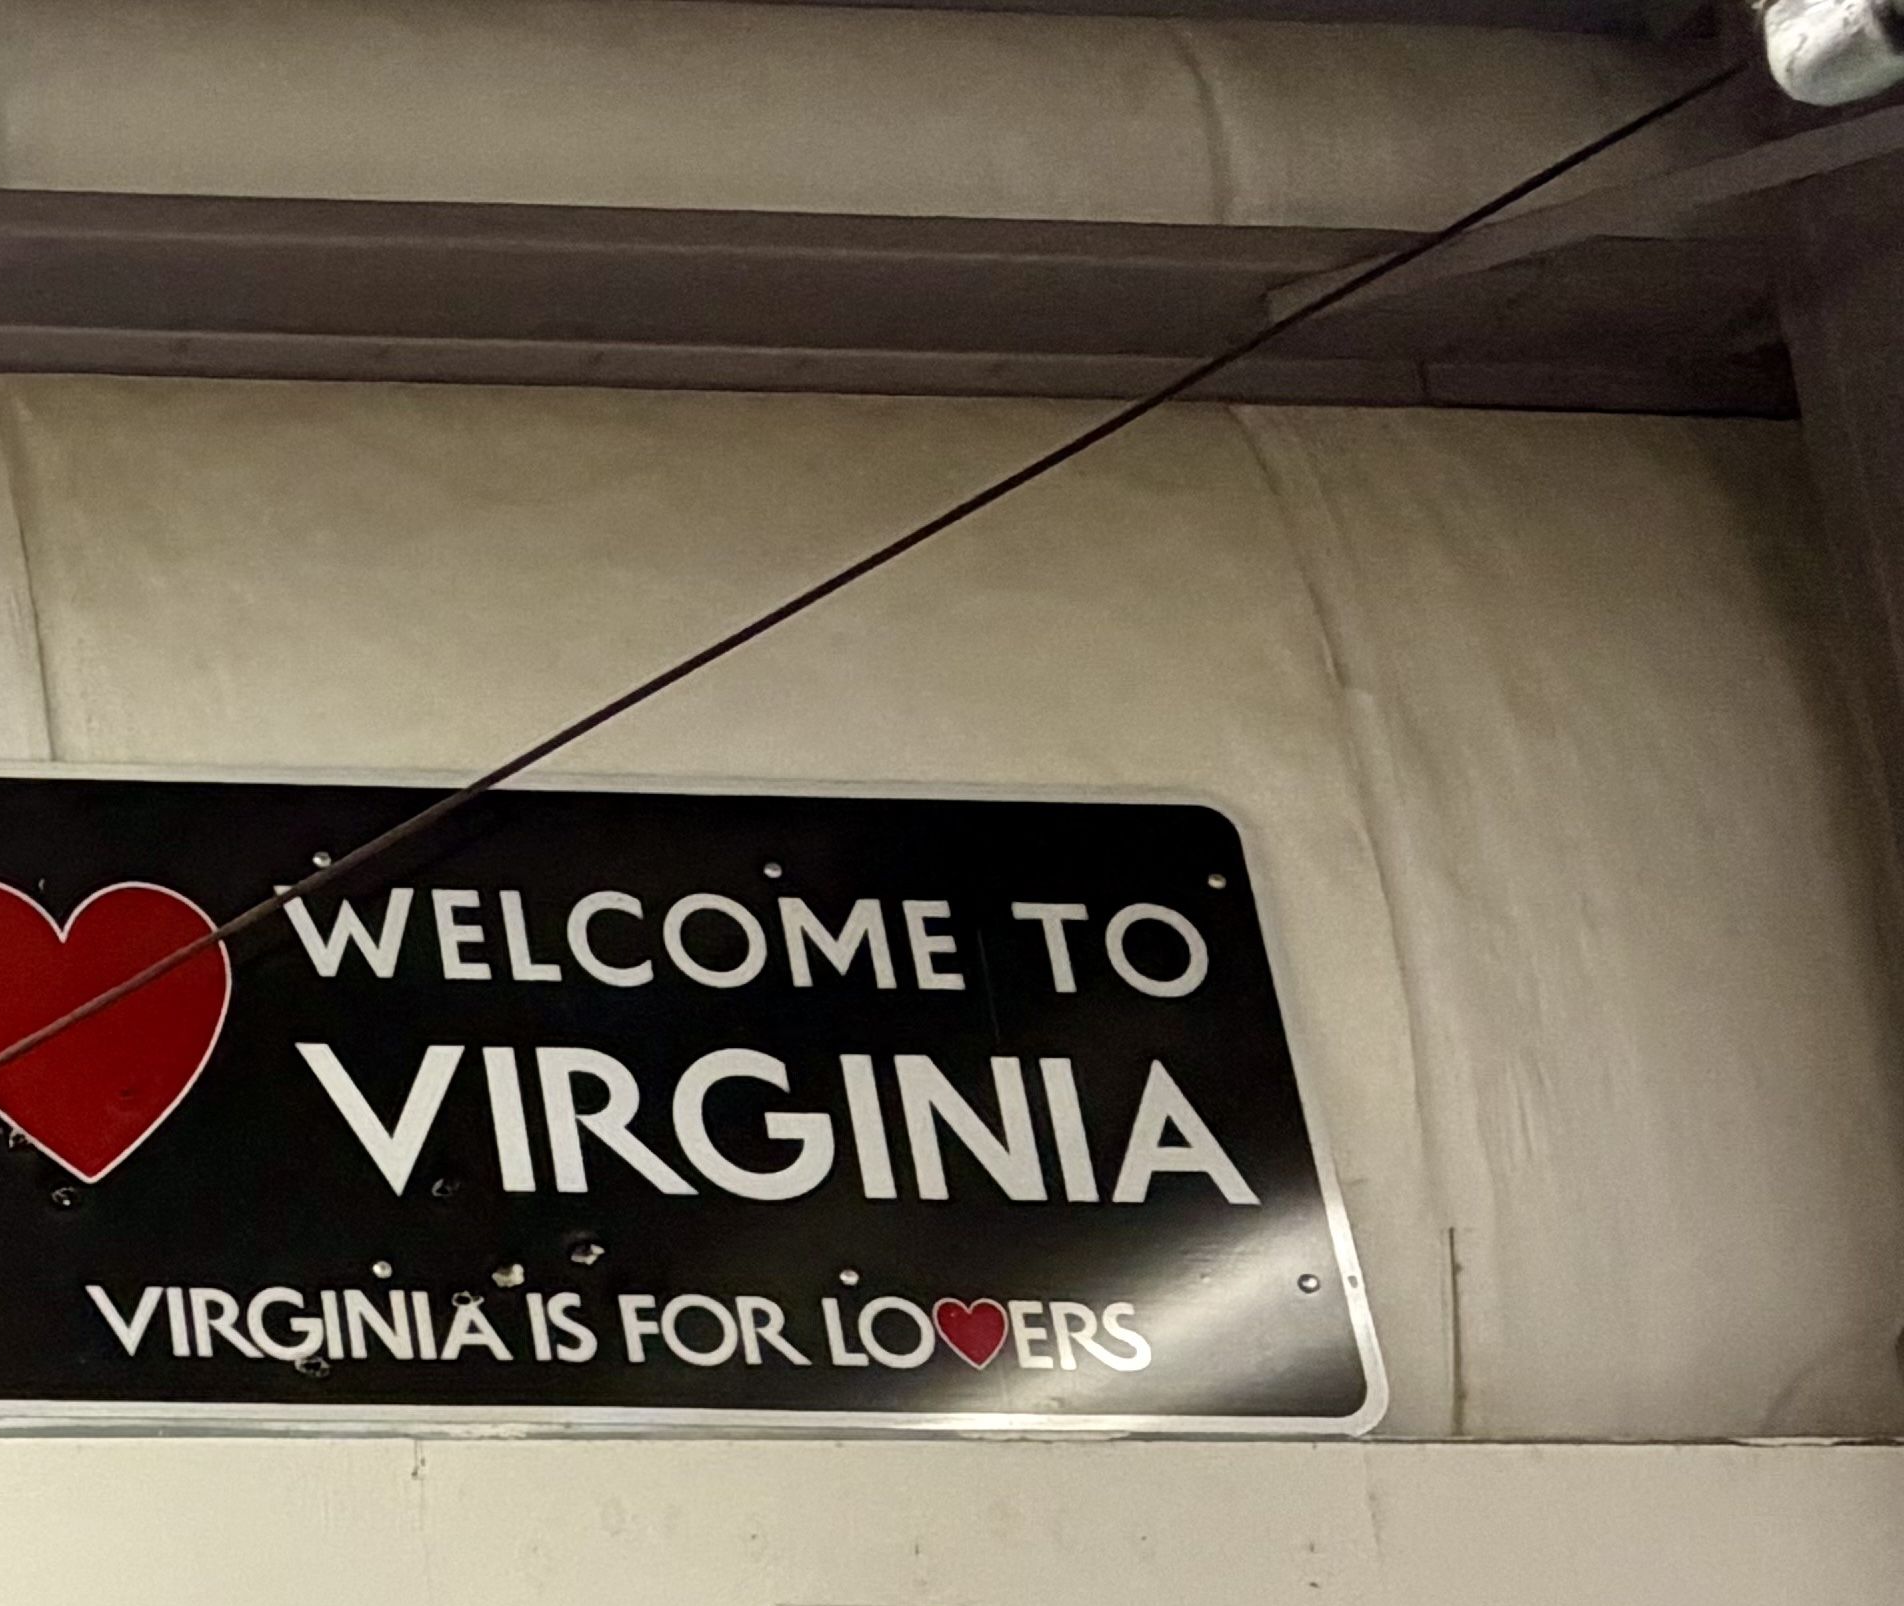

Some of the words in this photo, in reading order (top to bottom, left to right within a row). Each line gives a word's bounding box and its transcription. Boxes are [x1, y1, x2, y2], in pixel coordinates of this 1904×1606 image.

[274, 885, 965, 992] WELCOME
[1014, 900, 1209, 998] TO
[297, 1042, 1260, 1204] VIRGINIA
[87, 1282, 512, 1364] VIRGINIA
[536, 1290, 597, 1364] IS
[621, 1293, 811, 1368] FOR
